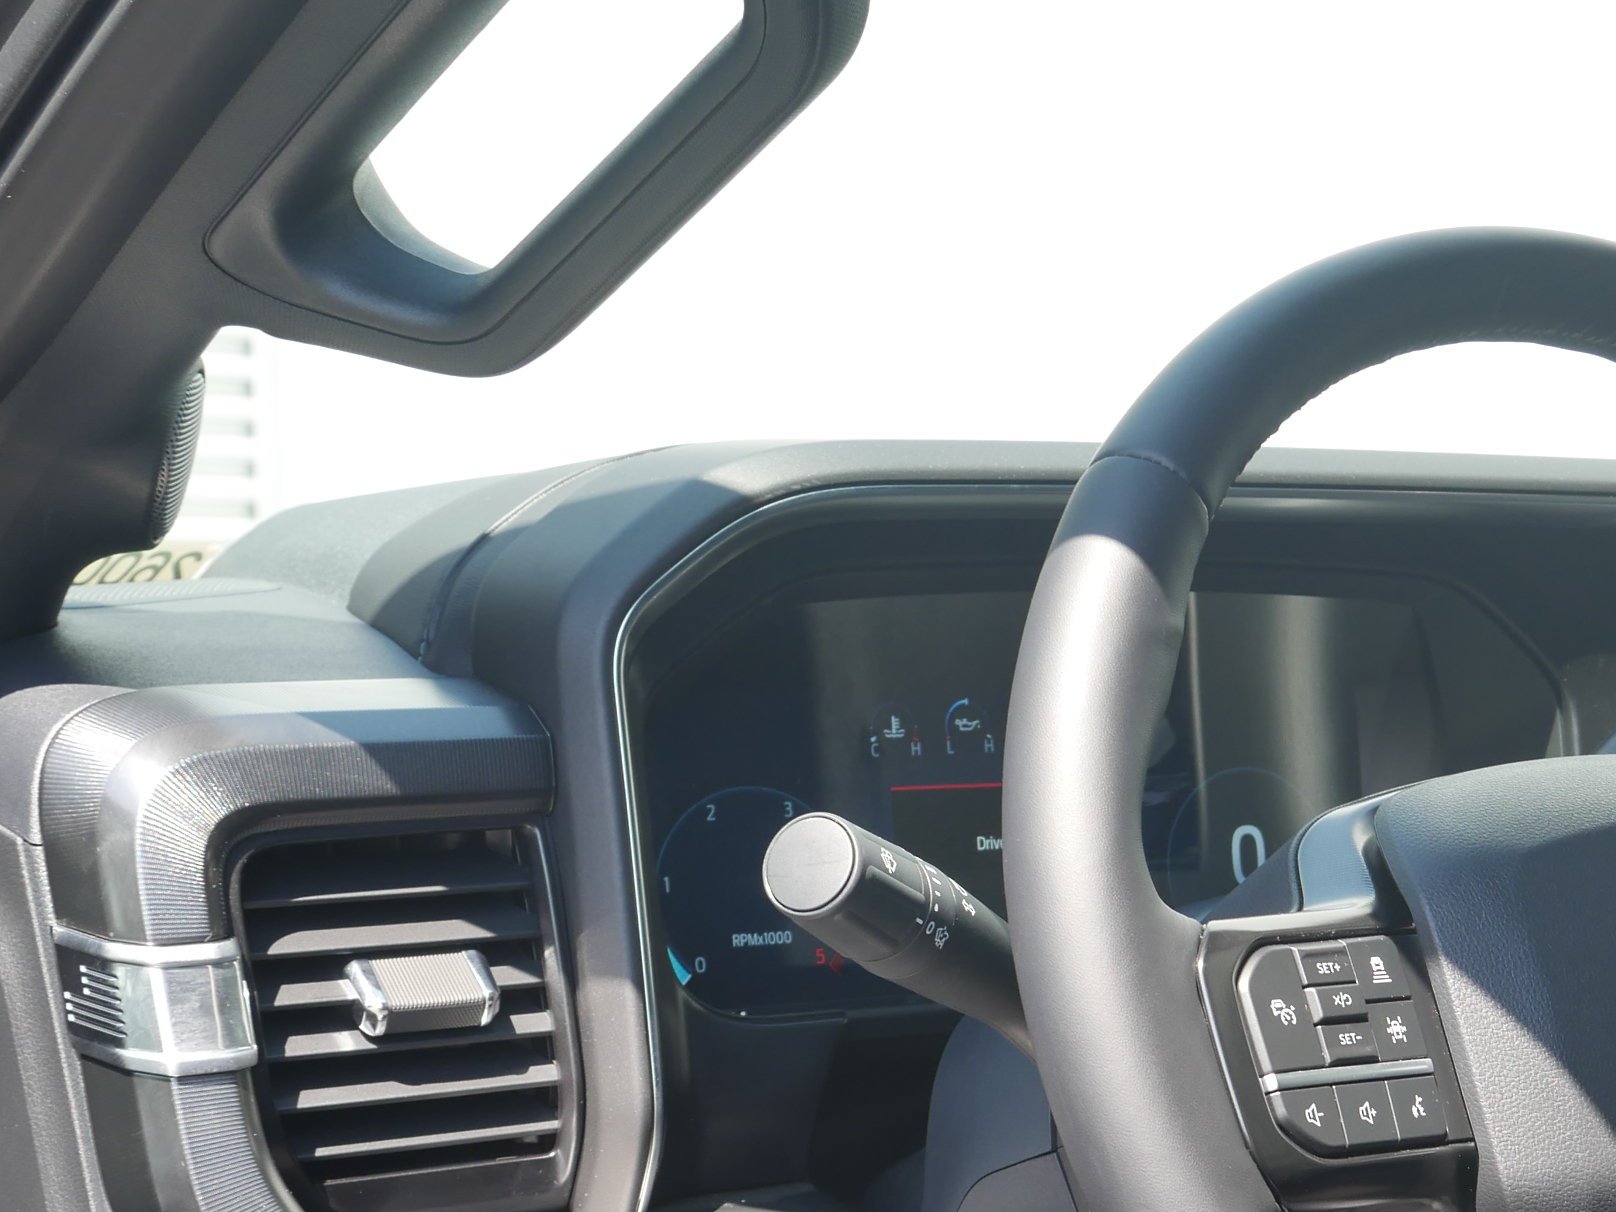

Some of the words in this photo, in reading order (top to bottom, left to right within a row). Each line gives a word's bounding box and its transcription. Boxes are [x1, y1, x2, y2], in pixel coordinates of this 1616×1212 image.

[870, 742, 880, 757] C
[910, 742, 922, 756] H
[946, 740, 955, 754] L
[984, 739, 995, 752] H
[706, 804, 717, 821] 2
[783, 801, 794, 817] 3
[1231, 824, 1266, 884] 0
[663, 876, 671, 894] 1
[732, 930, 792, 947] RPMx1000
[815, 948, 826, 964] 5
[694, 956, 706, 973] 0
[1316, 962, 1341, 974] SET+
[1338, 1033, 1363, 1045] SET-
